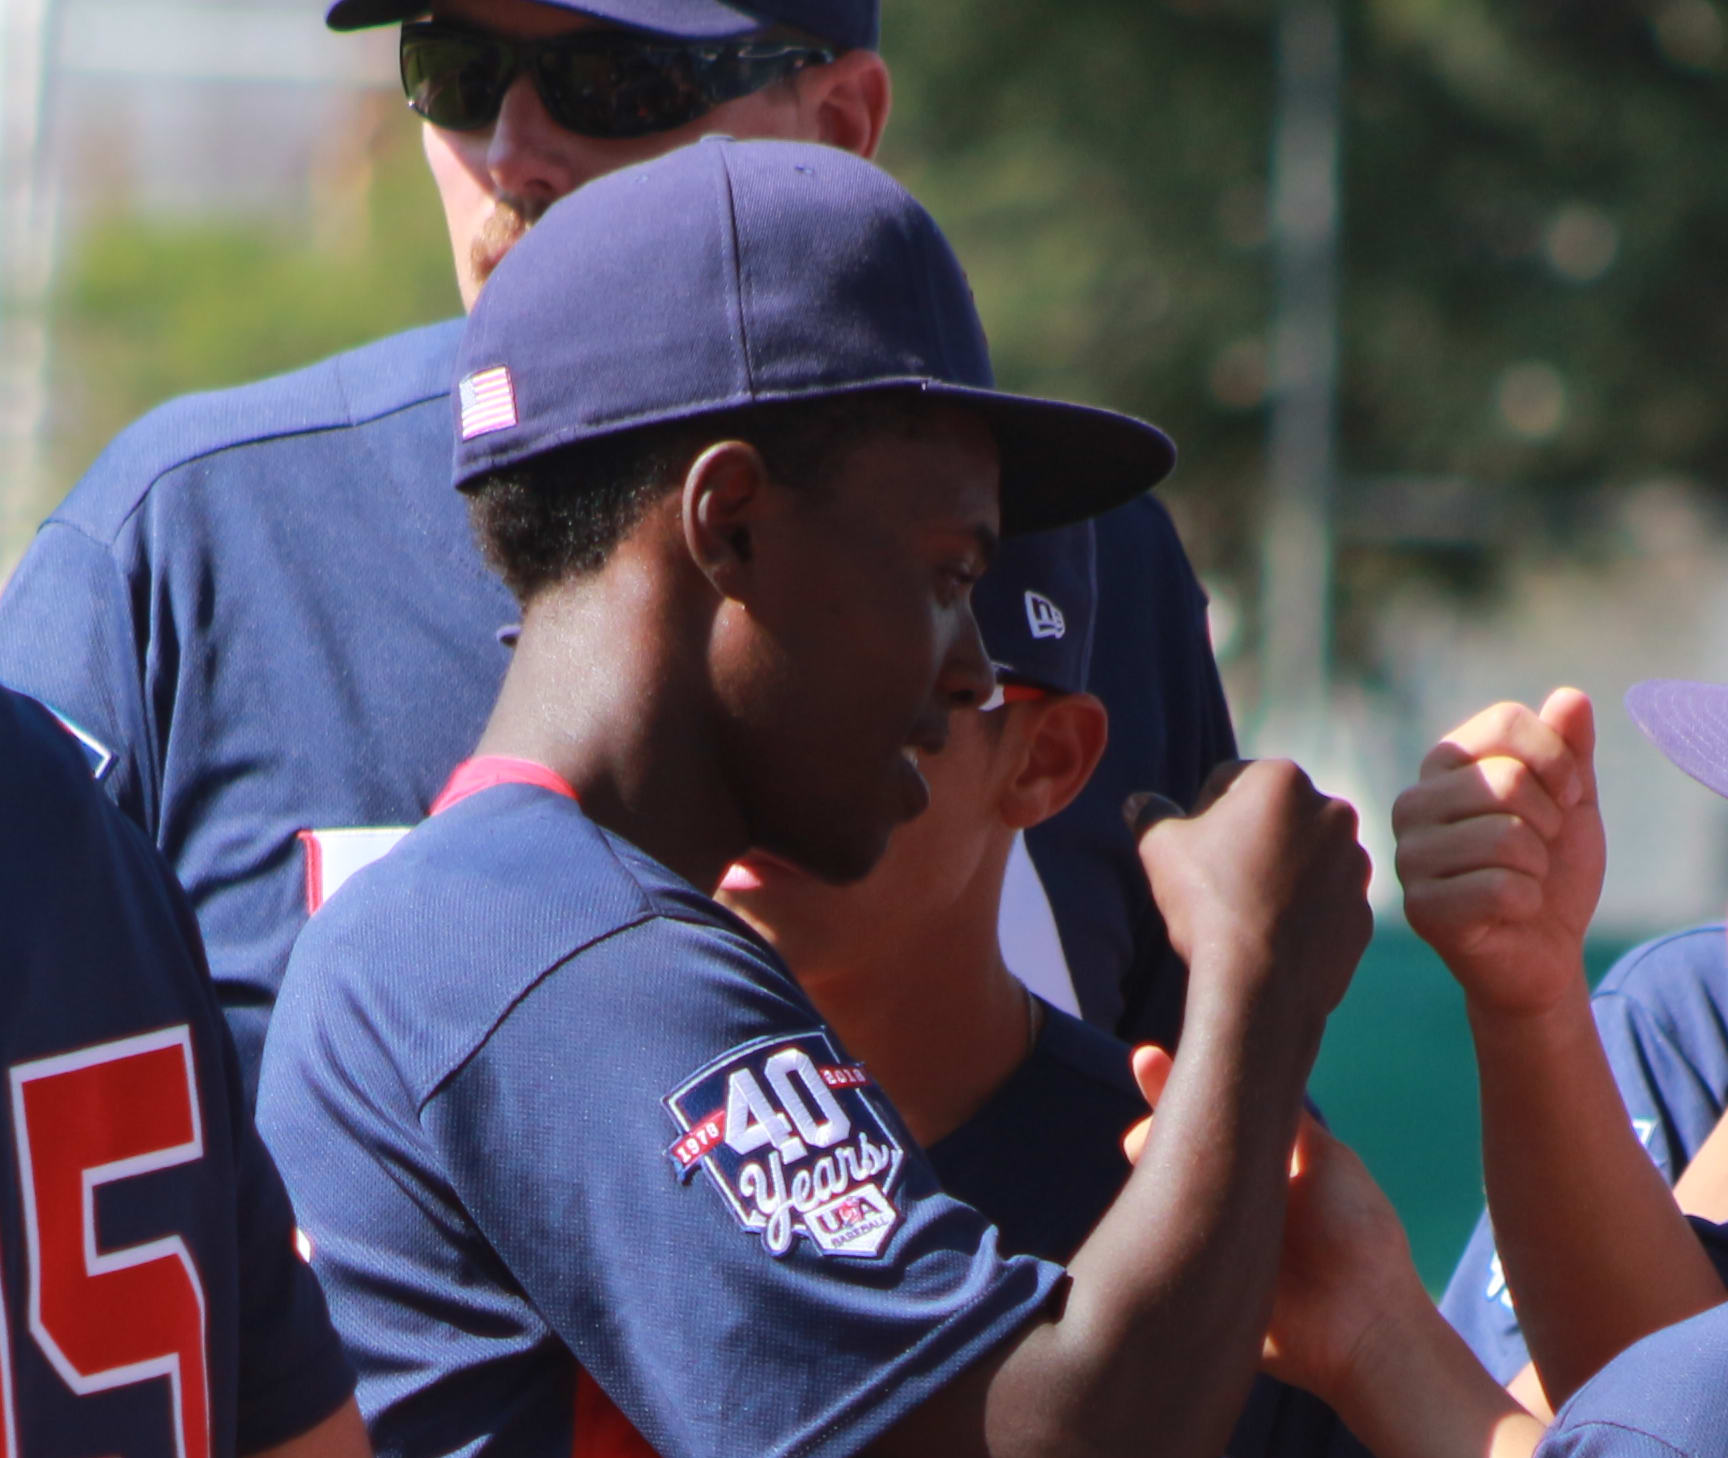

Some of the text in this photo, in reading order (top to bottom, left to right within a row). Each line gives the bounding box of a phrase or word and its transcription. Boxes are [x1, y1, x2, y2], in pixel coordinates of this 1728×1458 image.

[675, 1121, 720, 1164] 1978
[724, 1047, 852, 1166] 40
[739, 1131, 890, 1252] Years
